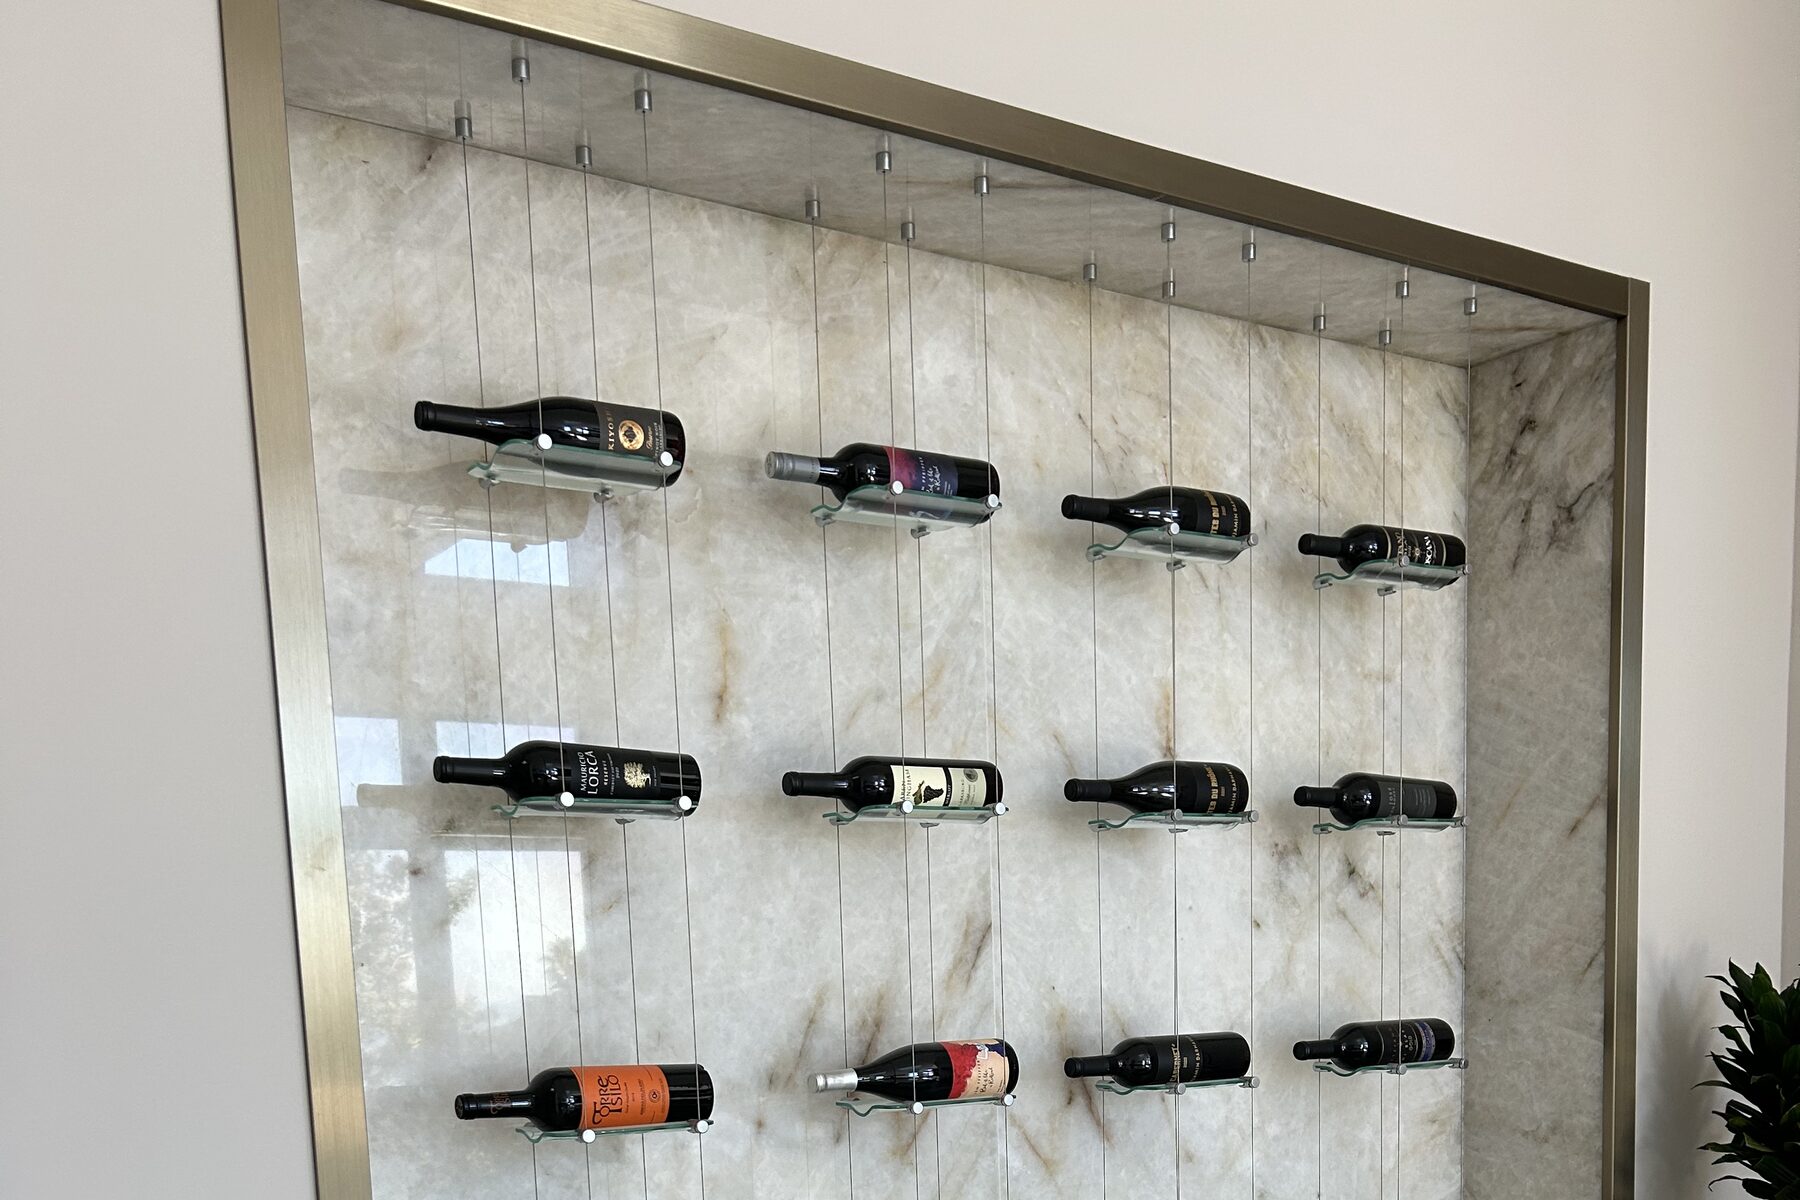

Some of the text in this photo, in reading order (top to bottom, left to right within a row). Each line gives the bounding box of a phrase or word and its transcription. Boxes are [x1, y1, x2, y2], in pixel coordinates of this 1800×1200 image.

[577, 751, 587, 792] MAURICIO
[584, 750, 599, 795] LORCA
[1211, 788, 1218, 800] DU
